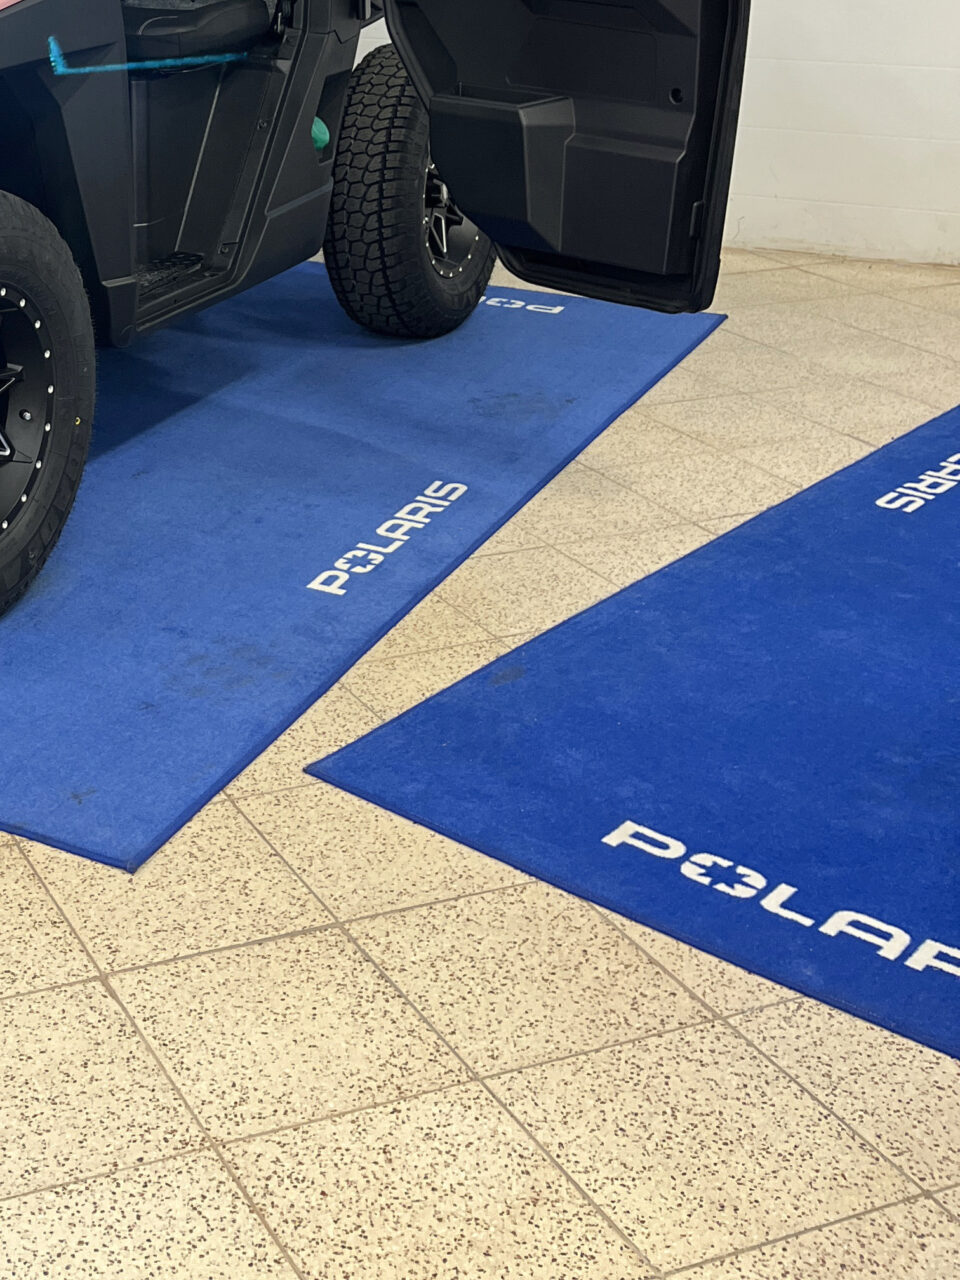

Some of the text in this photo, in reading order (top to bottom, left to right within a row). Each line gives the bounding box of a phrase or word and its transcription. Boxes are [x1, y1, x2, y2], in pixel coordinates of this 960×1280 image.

[479, 295, 565, 314] PO
[875, 452, 960, 513] ARIS
[306, 480, 468, 596] POLARIS
